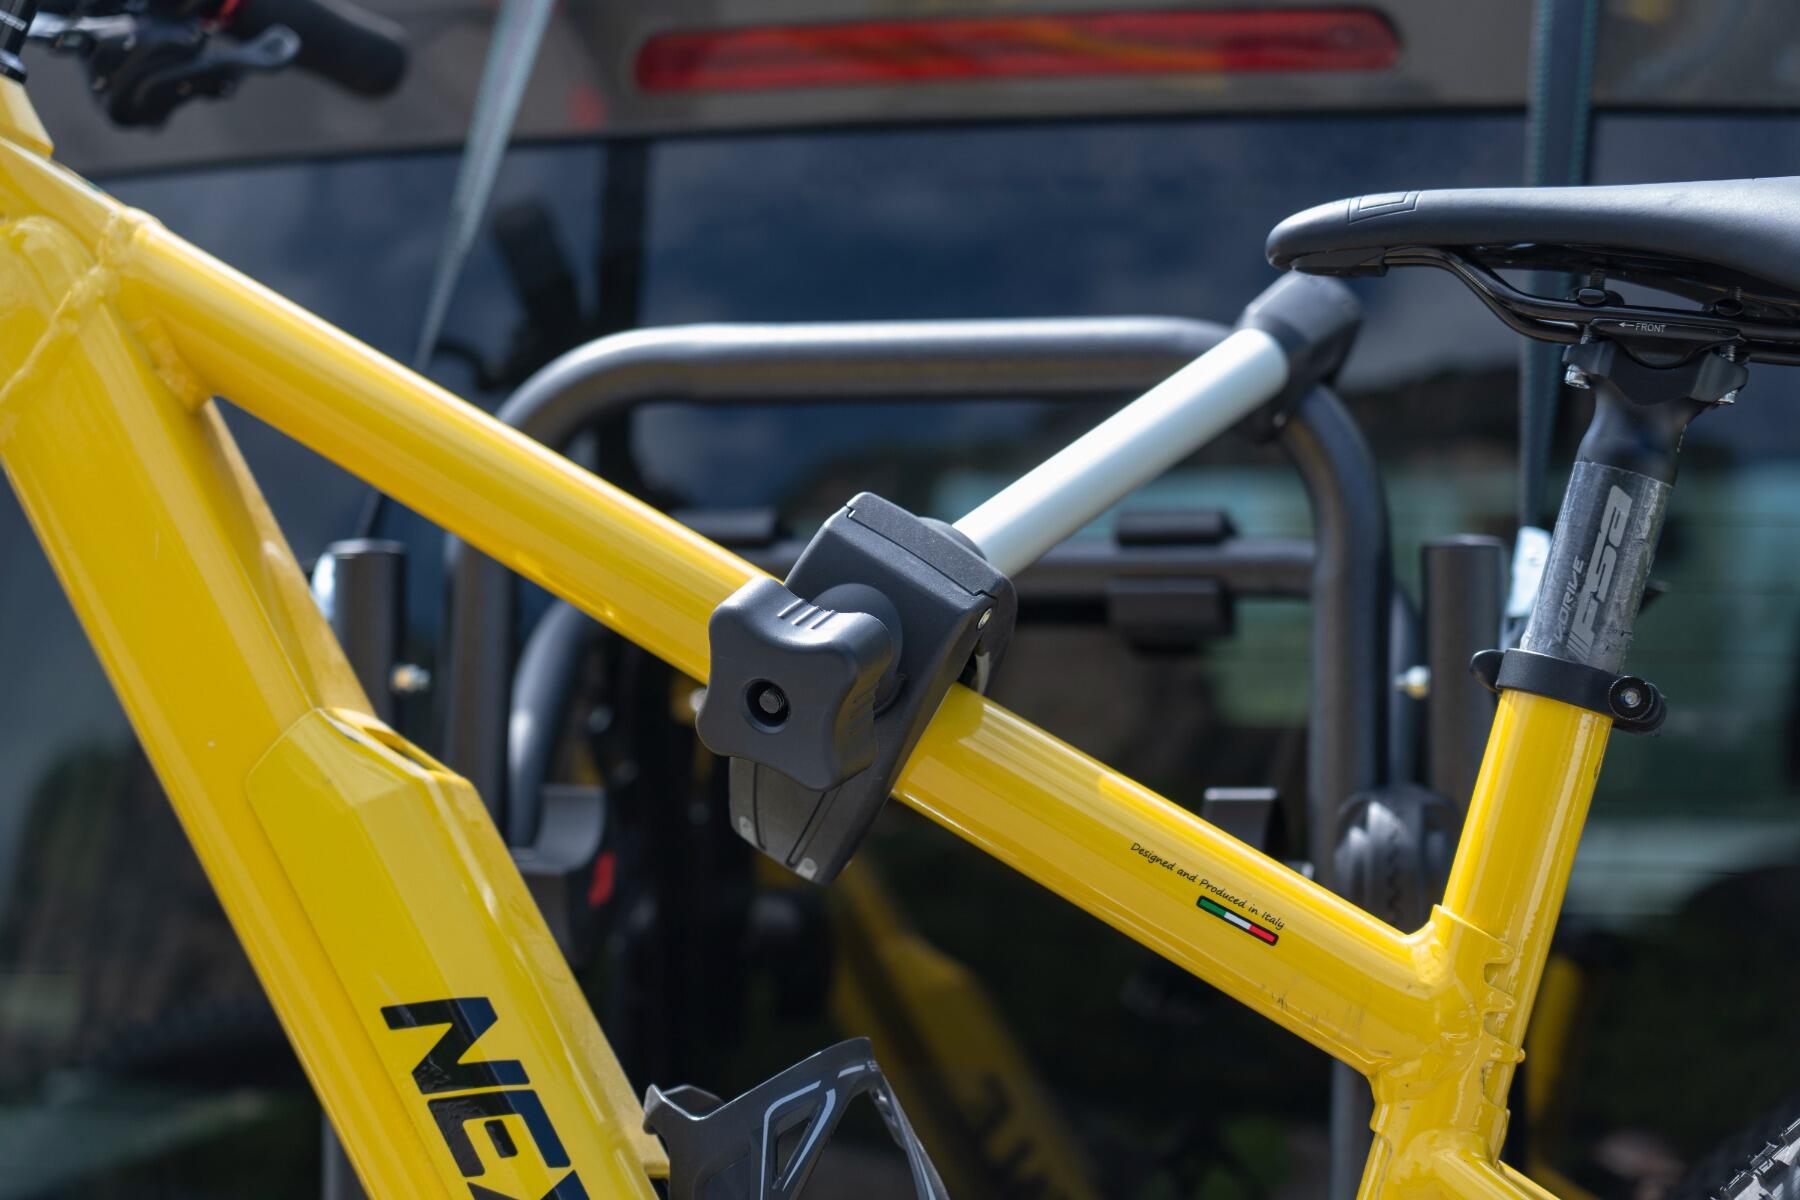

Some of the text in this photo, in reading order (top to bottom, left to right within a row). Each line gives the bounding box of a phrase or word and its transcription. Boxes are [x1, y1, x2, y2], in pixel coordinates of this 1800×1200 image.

[1635, 322, 1666, 333] FRONT
[1130, 842, 1285, 930] Designed and Produced in Italy
[380, 996, 591, 1200] NE
